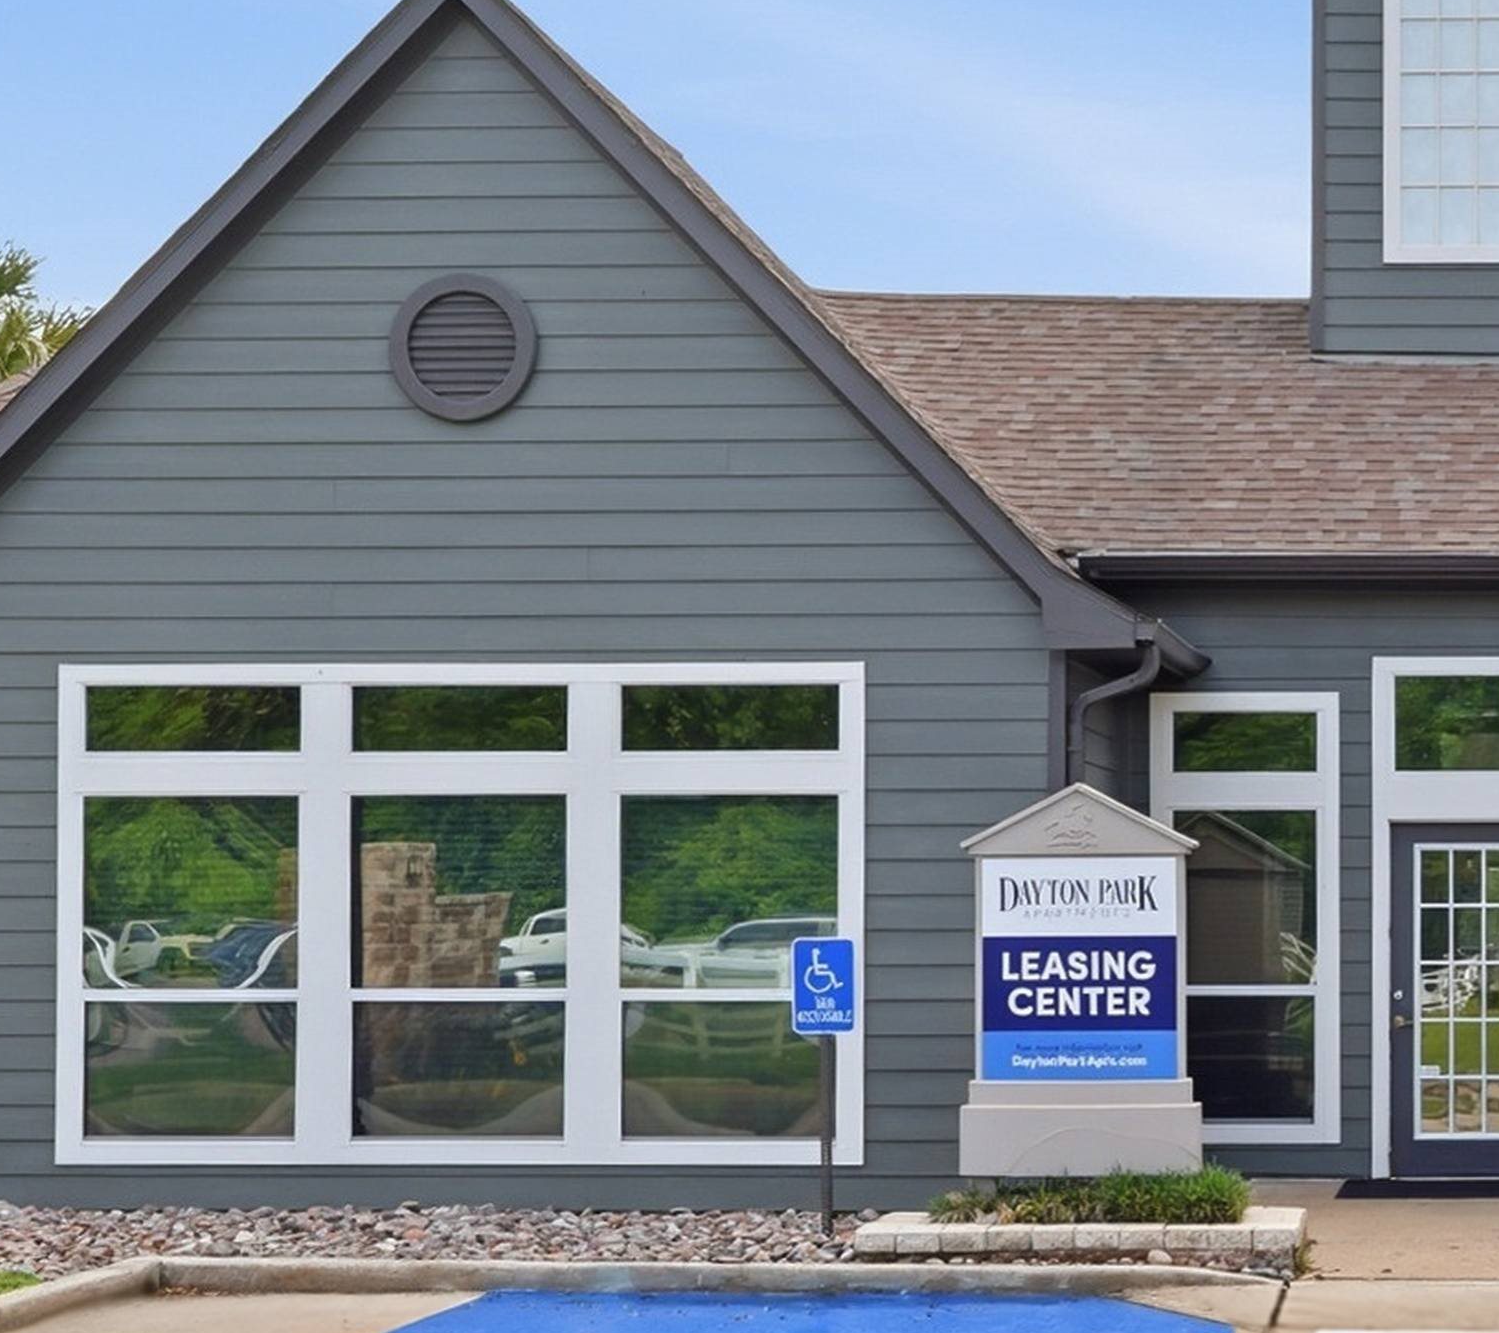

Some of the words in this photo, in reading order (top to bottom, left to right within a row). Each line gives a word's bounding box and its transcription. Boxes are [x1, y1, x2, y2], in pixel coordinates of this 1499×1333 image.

[999, 877, 1090, 912] DAYTON
[1099, 875, 1158, 911] PARK
[1002, 951, 1157, 981] LEASING
[1007, 986, 1152, 1016] CENTER
